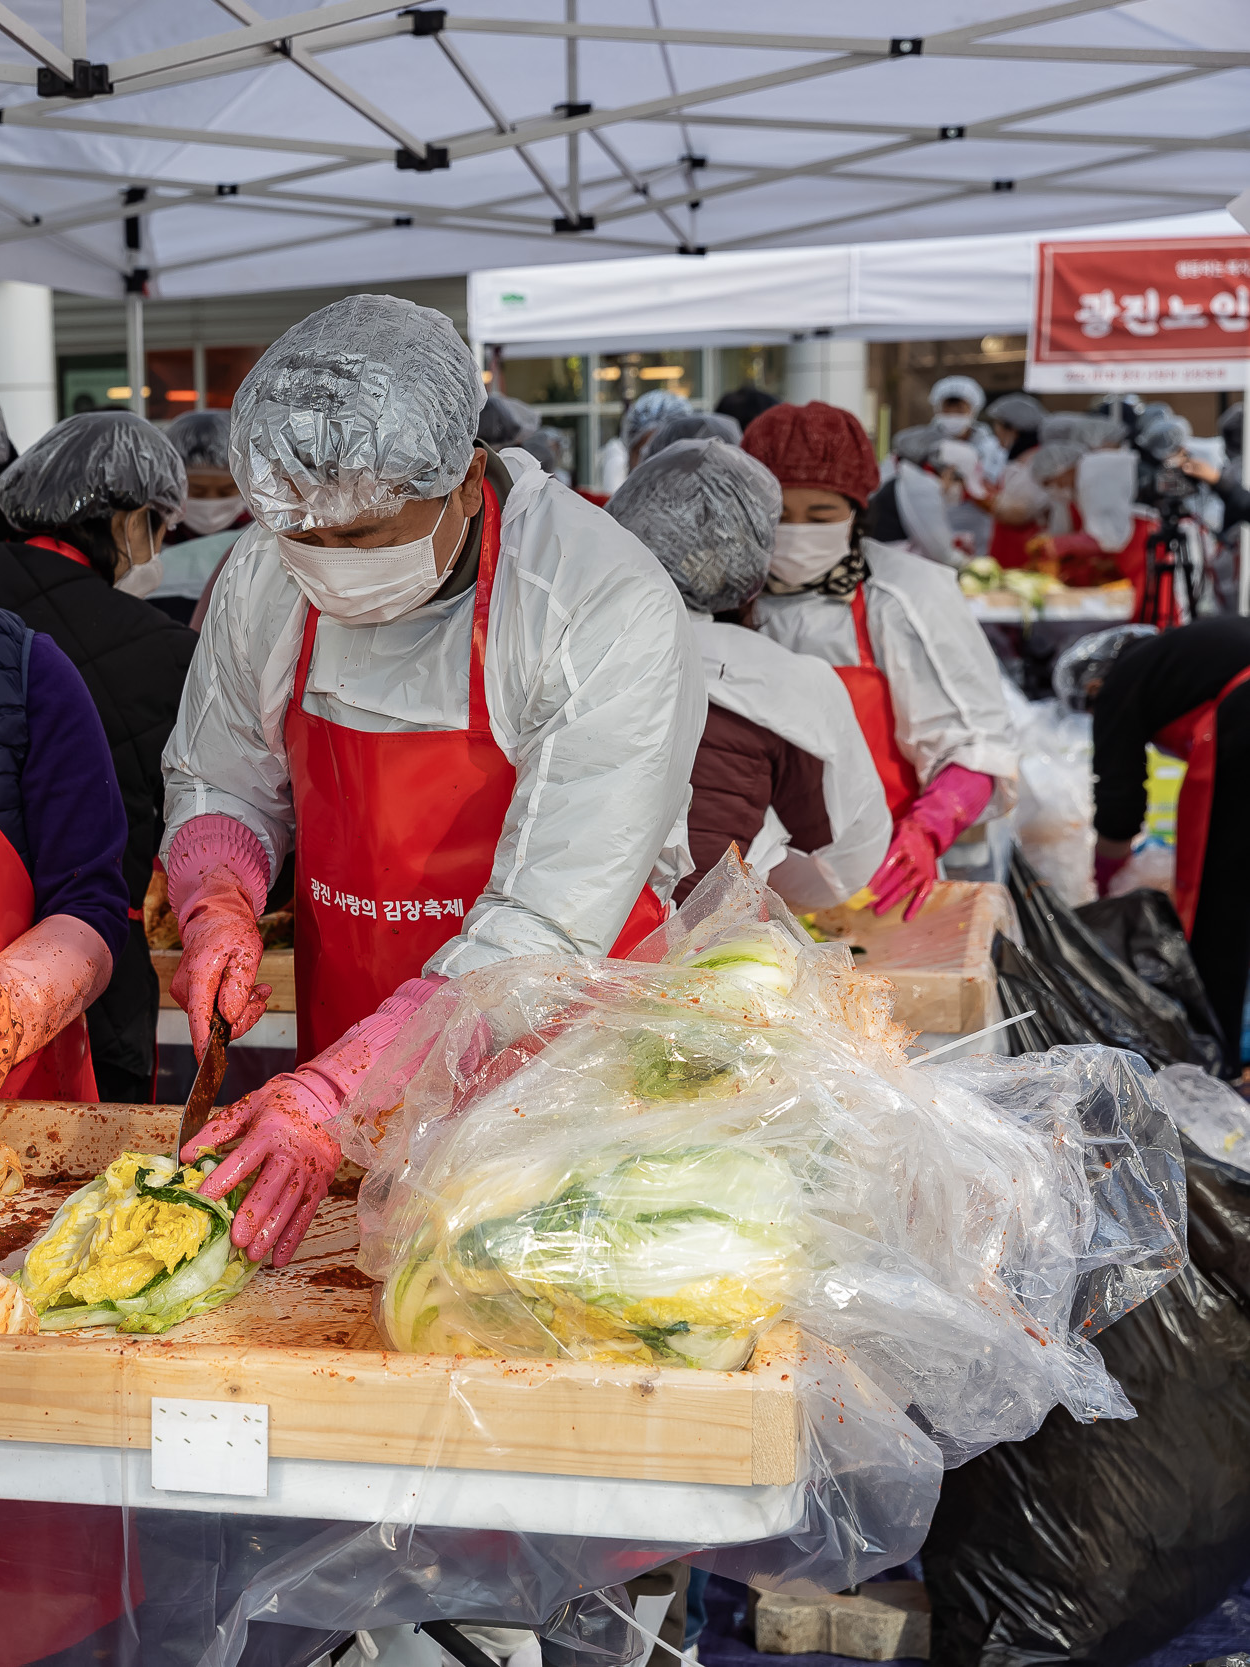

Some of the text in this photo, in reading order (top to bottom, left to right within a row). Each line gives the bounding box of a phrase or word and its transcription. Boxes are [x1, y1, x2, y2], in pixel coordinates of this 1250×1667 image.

[1075, 286, 1250, 338] 광진노인
[310, 877, 464, 921] 광진 사랑의 김장축제
